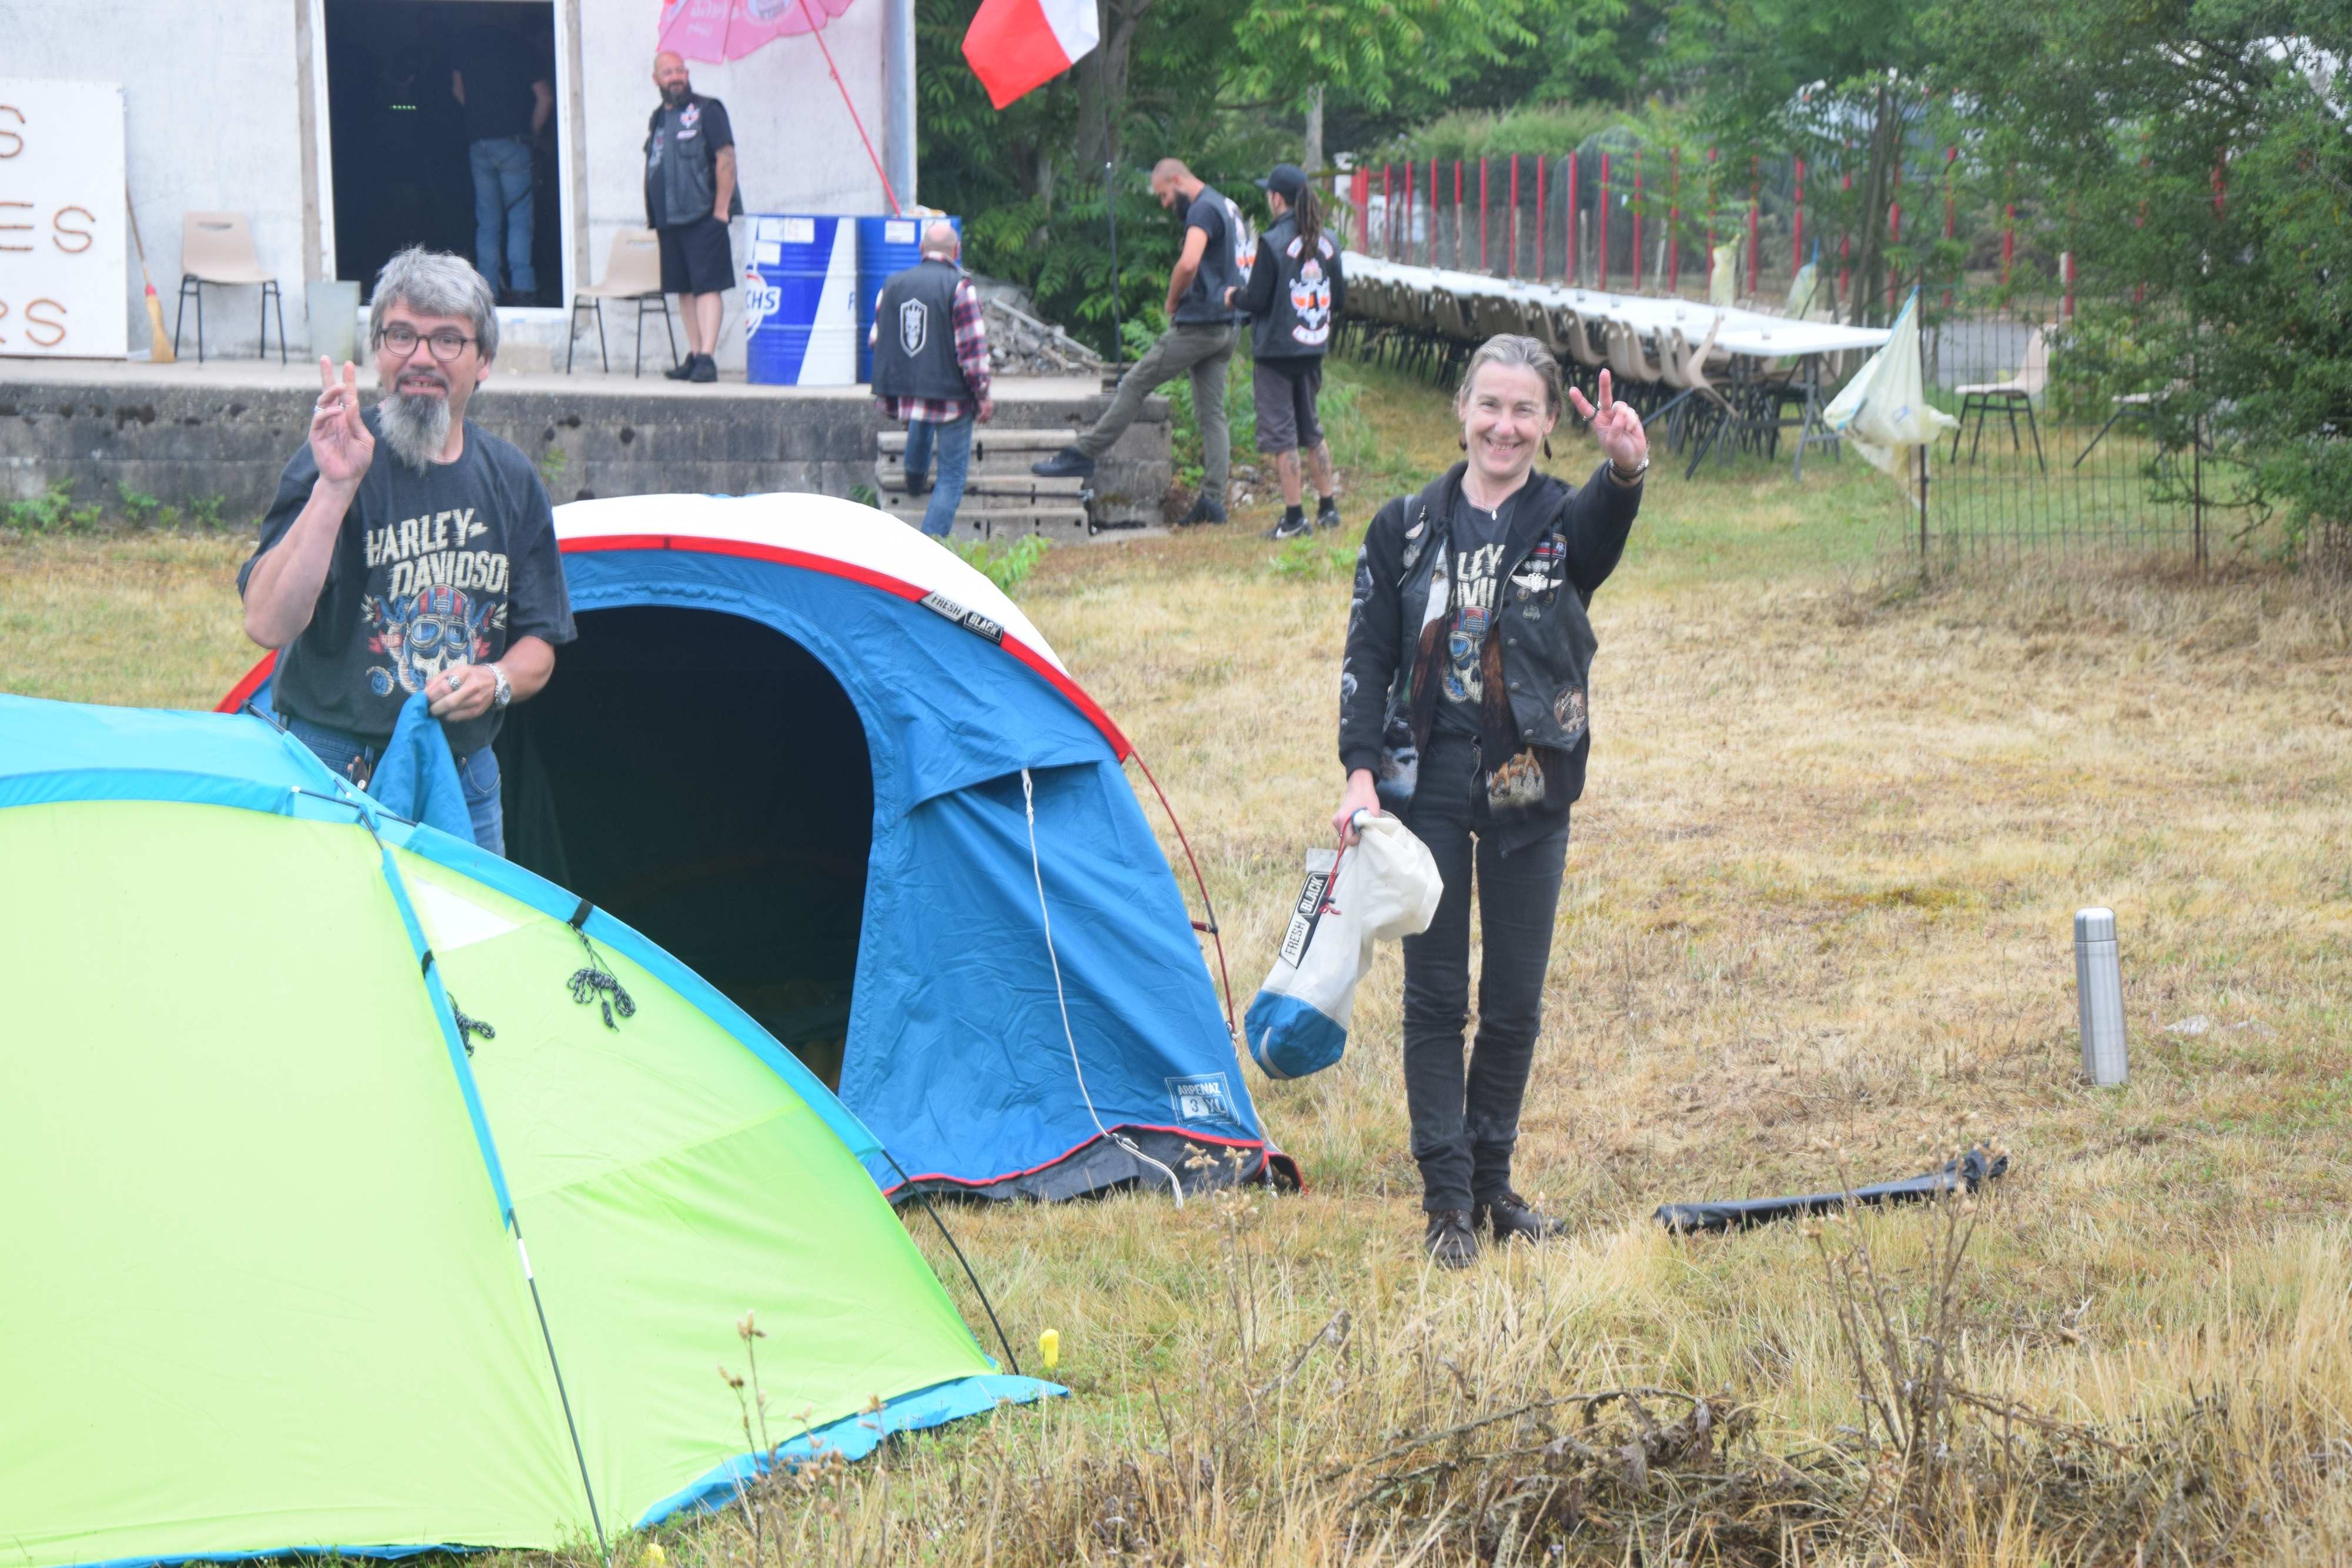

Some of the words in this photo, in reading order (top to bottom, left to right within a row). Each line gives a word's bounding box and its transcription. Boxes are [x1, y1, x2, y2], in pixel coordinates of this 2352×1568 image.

[387, 550, 509, 603] DAVIDSO
[932, 594, 962, 616] FRESH
[969, 613, 1000, 636] BLACK
[1285, 921, 1305, 955] FRESH
[1300, 876, 1324, 913] BLACK
[1178, 1082, 1221, 1096] ARPENAZ
[1190, 1098, 1199, 1112] 3
[1203, 1097, 1227, 1114] XL
